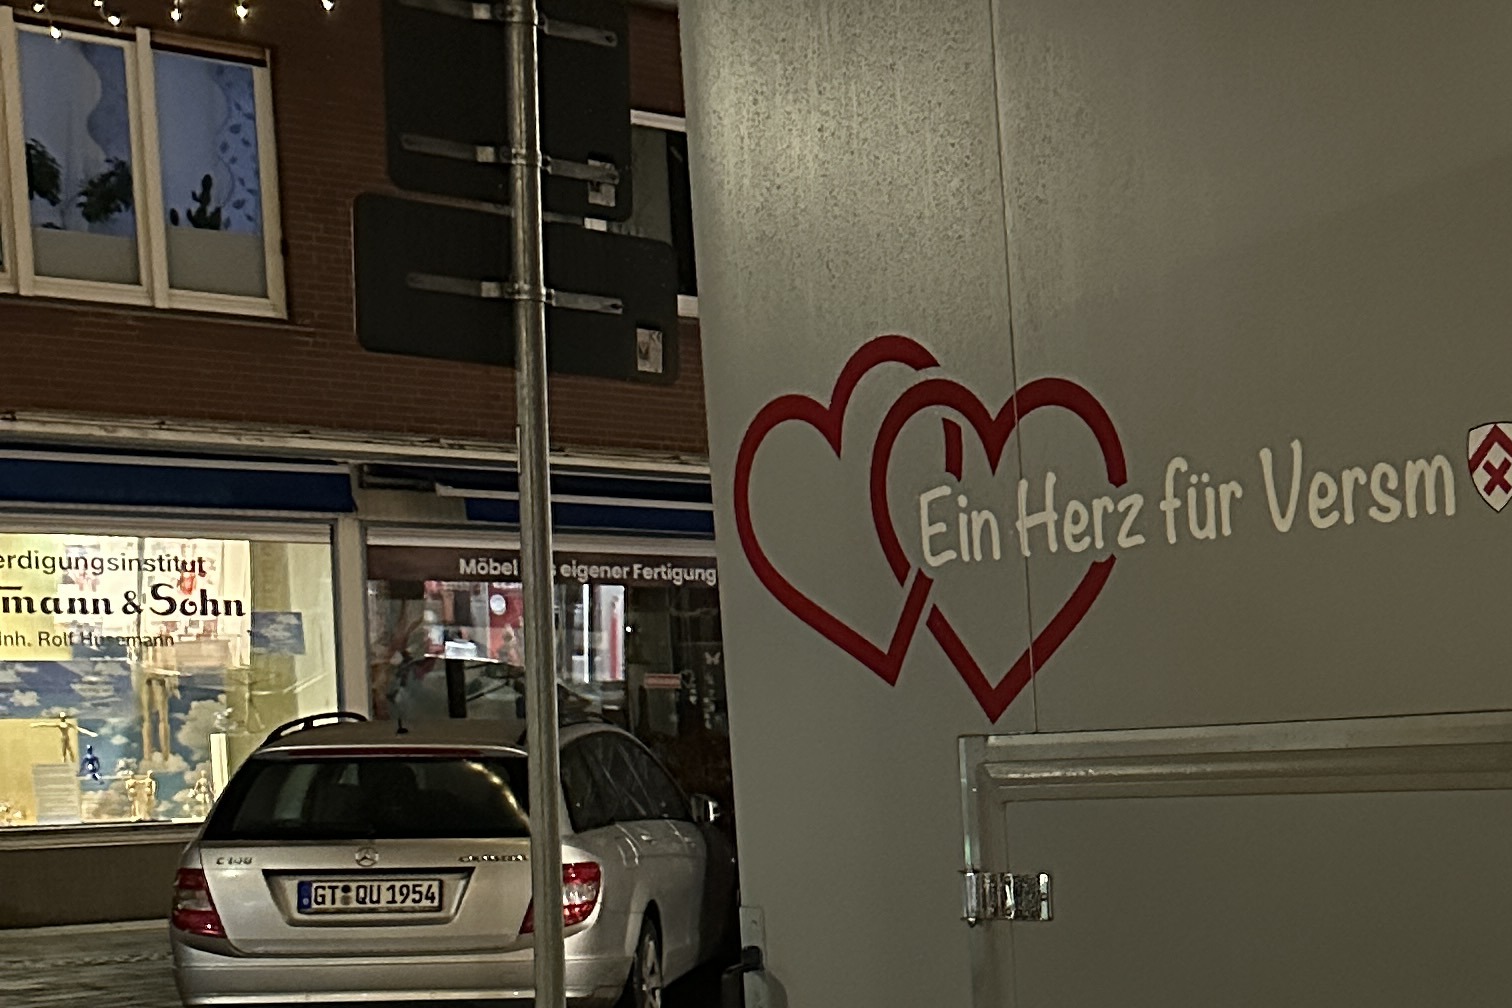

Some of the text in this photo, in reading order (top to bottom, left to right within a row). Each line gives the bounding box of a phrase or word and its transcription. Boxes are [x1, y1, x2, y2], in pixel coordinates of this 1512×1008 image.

[919, 484, 1001, 569] Ein
[1013, 470, 1146, 558] Herz
[1159, 456, 1244, 543] für
[459, 558, 518, 576] Möbel
[560, 560, 630, 583] eigener
[632, 563, 718, 587] Fertigung
[121, 590, 143, 615] &
[150, 583, 246, 617] Sohn
[38, 631, 73, 647] Rolf
[81, 631, 175, 648] Huemann
[313, 884, 436, 905] GT QU 1954
